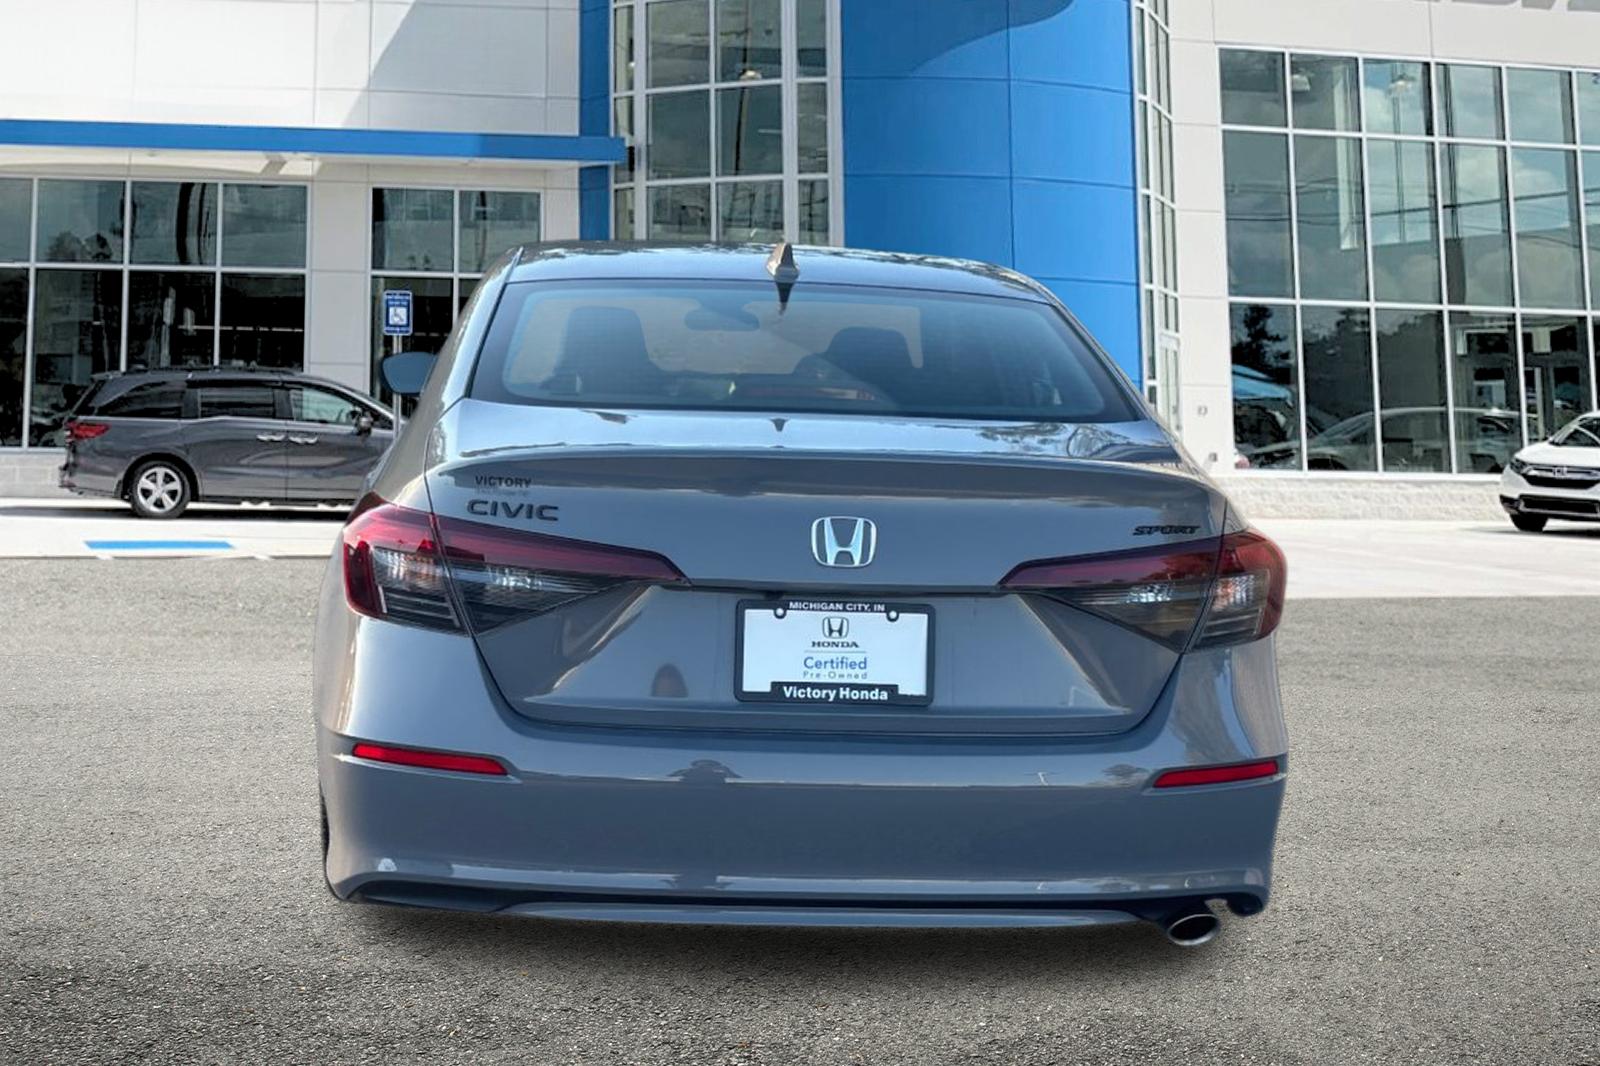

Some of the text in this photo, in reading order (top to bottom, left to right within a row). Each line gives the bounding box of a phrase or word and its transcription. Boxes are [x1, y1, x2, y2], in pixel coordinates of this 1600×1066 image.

[475, 476, 531, 488] VICTORY
[467, 499, 559, 521] CIVIC
[1133, 525, 1201, 536] SPORT
[789, 602, 885, 612] MICHIGAN CITY, IN
[803, 656, 868, 670] Certified
[802, 671, 868, 680] Pre-Owned
[783, 686, 888, 702] Victory Honda
